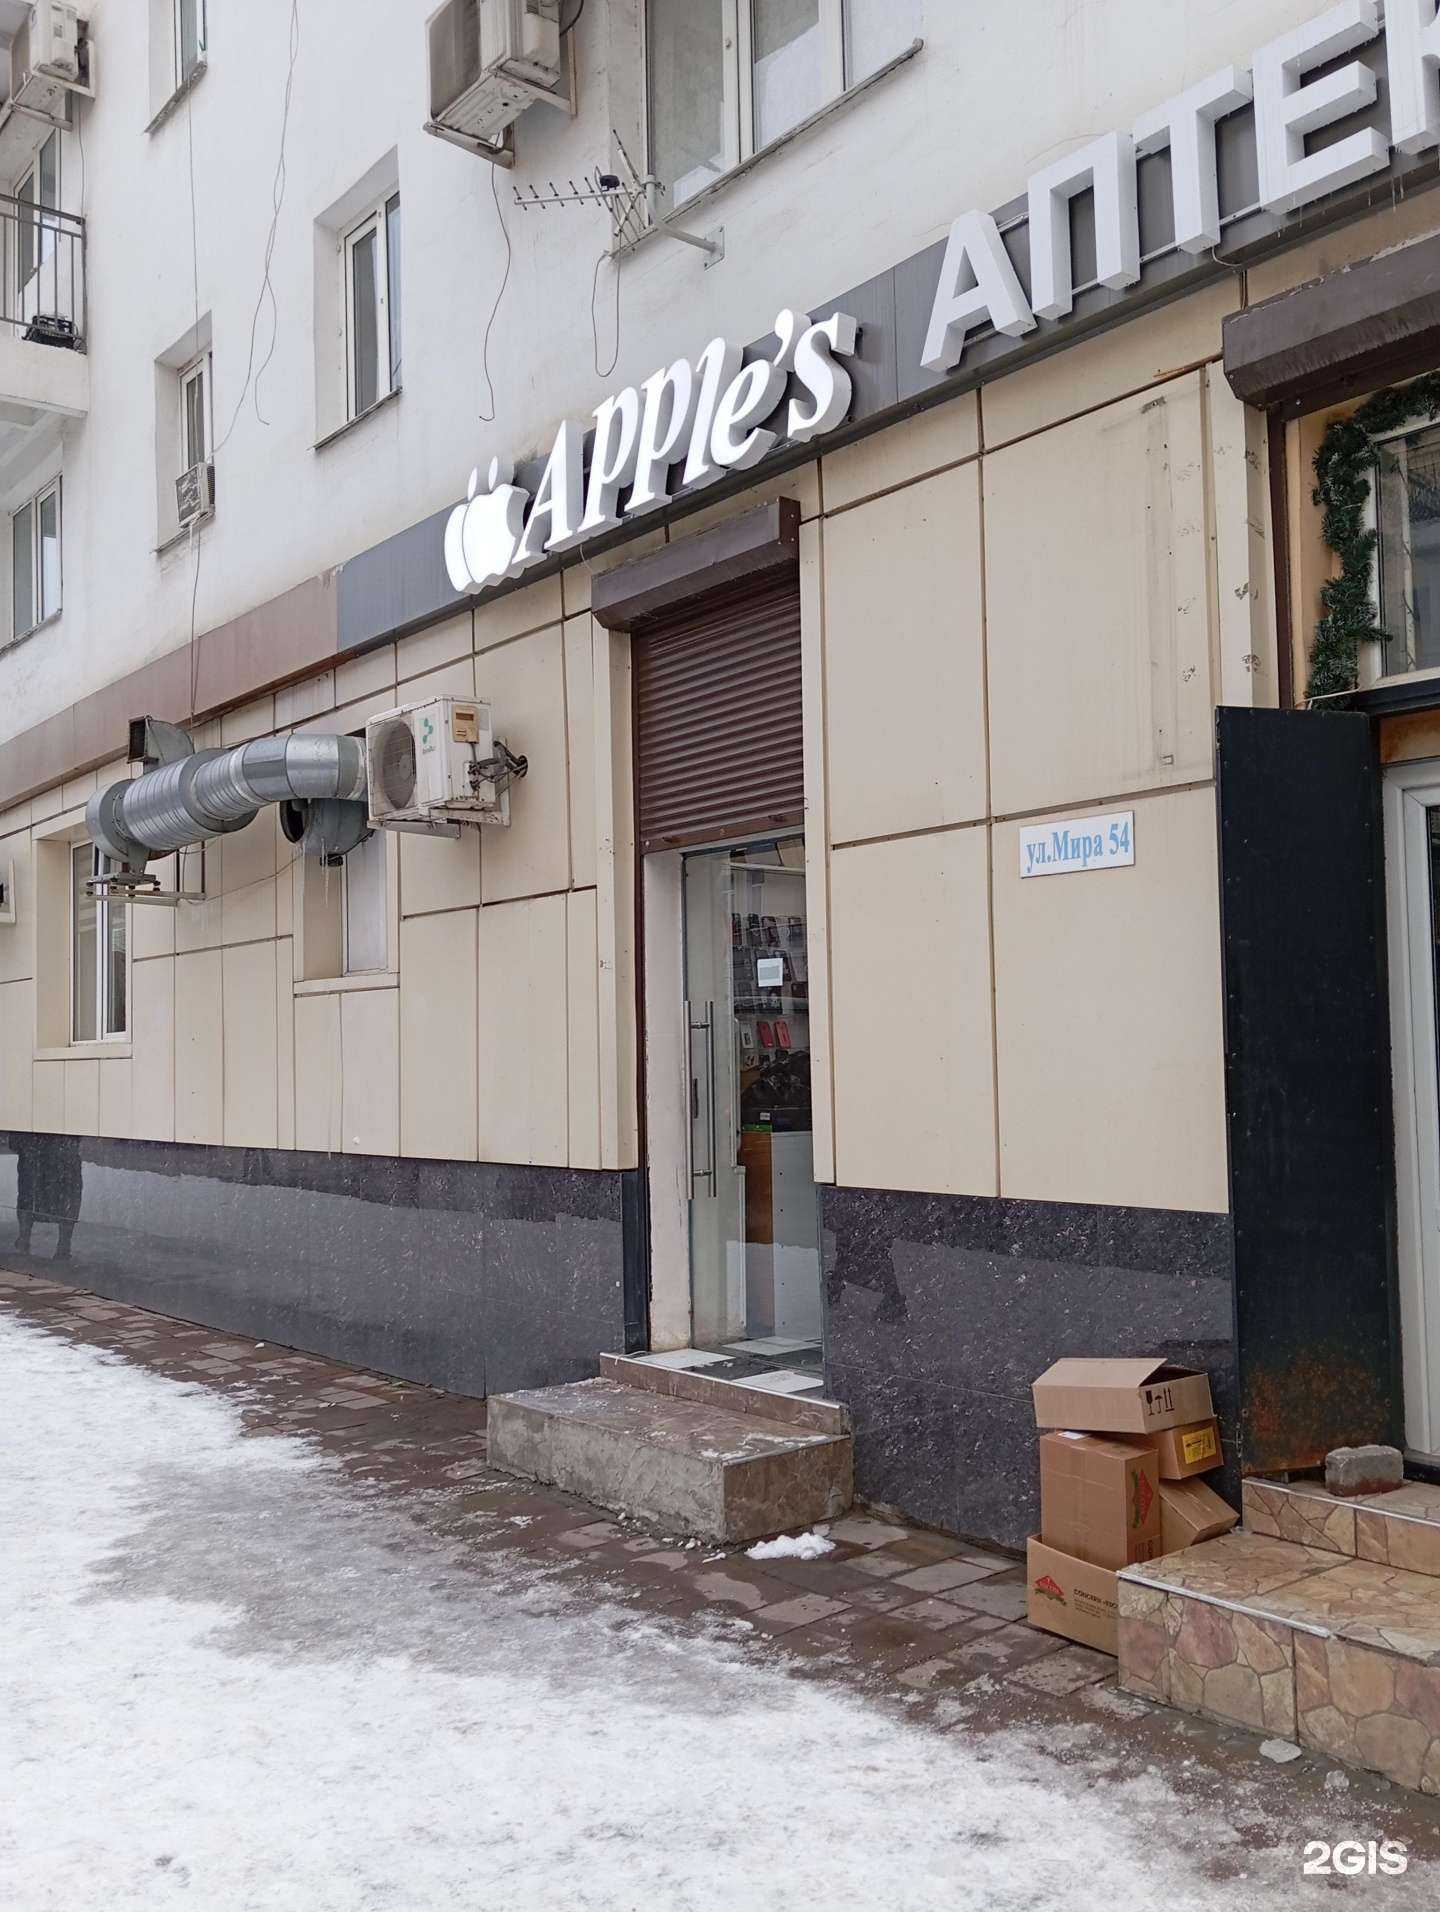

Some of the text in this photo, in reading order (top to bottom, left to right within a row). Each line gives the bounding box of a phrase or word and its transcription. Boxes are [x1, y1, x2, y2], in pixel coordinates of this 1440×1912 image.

[511, 308, 858, 567] Apple's
[1026, 821, 1130, 874] ул.Мира 54
